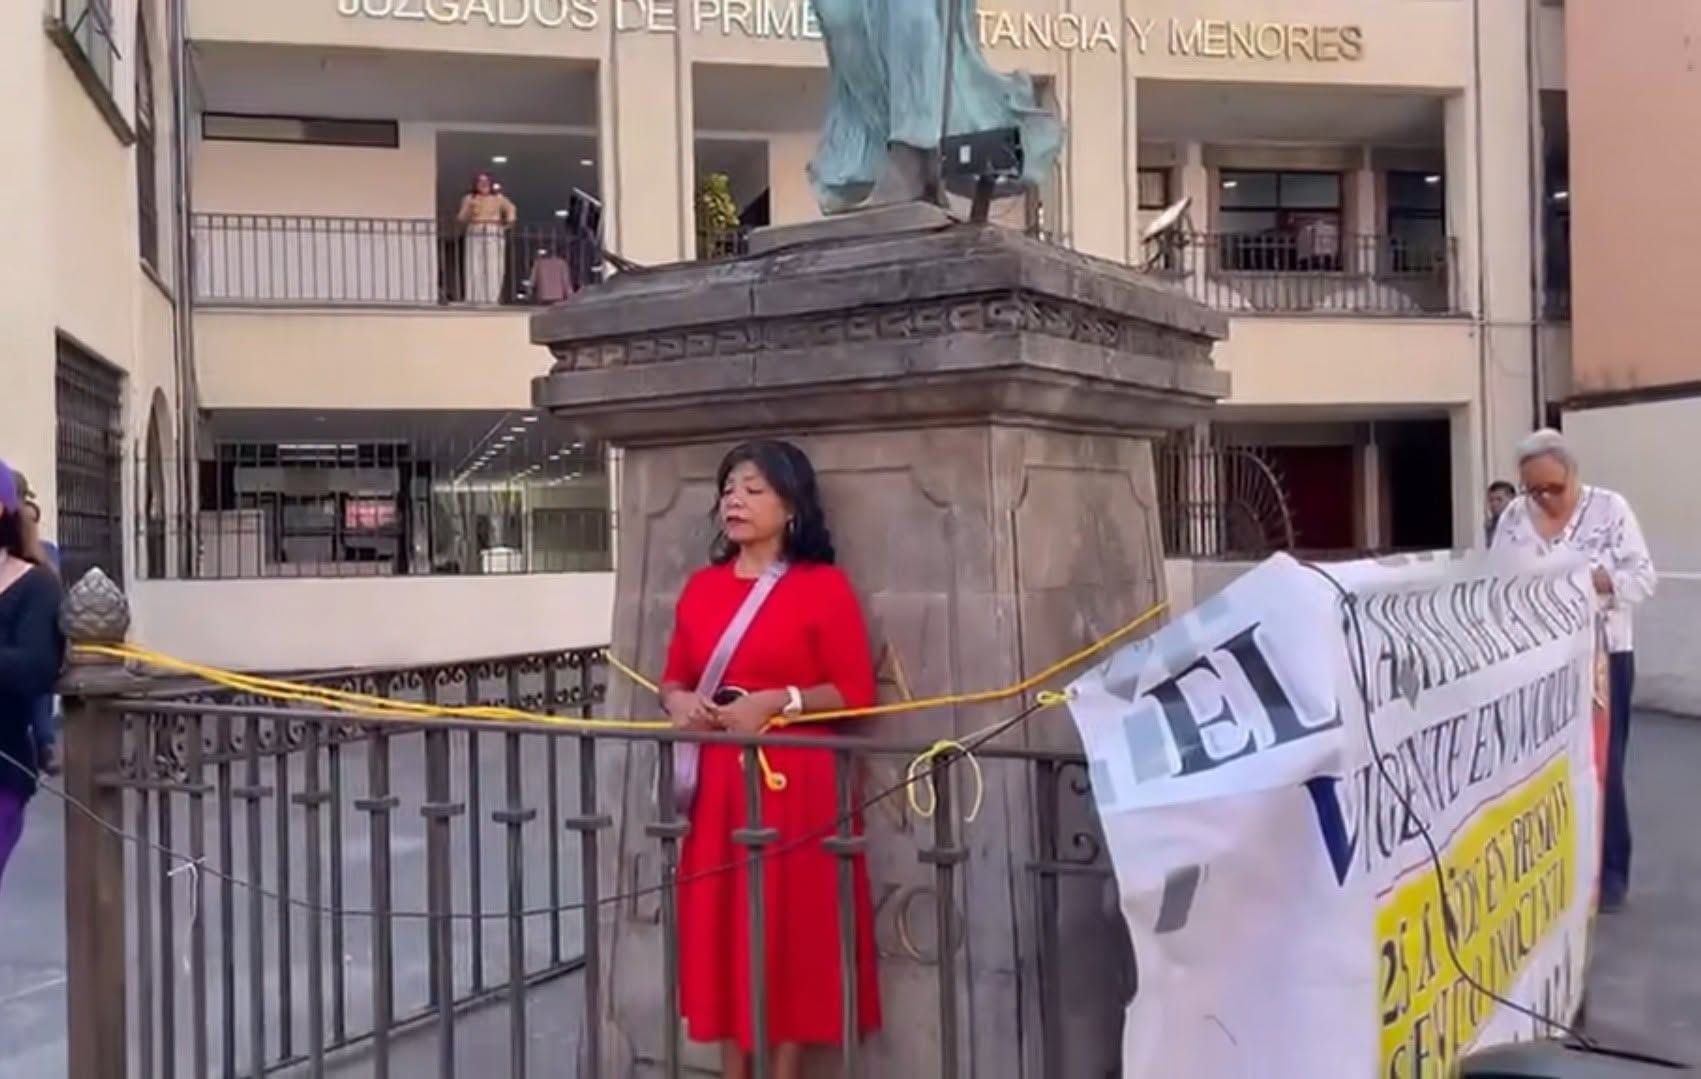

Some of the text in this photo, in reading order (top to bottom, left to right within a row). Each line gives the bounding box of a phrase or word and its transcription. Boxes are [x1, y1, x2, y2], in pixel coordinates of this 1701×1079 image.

[616, 0, 676, 33] DE
[1126, 15, 1157, 54] Y
[1168, 19, 1363, 62] MENORES
